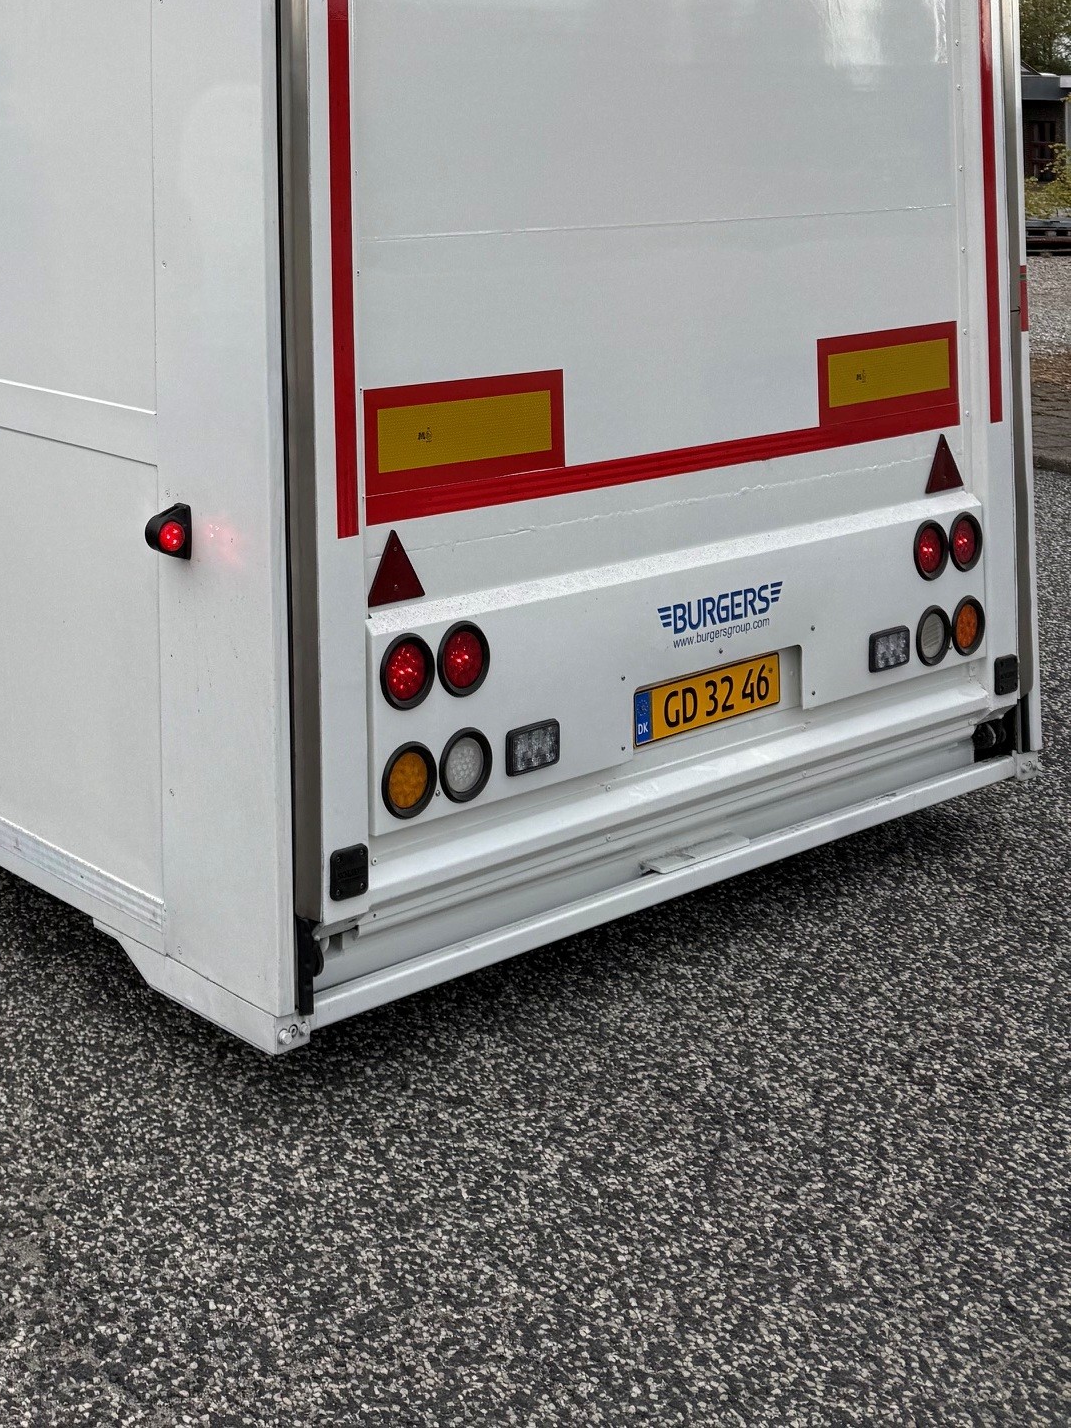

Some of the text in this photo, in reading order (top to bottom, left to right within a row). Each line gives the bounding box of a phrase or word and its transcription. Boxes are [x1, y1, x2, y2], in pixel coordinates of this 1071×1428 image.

[673, 584, 771, 635] BURGERS
[672, 617, 770, 649] www.burgersgroup.com
[663, 663, 770, 728] GD 32 46
[637, 721, 649, 735] DK
